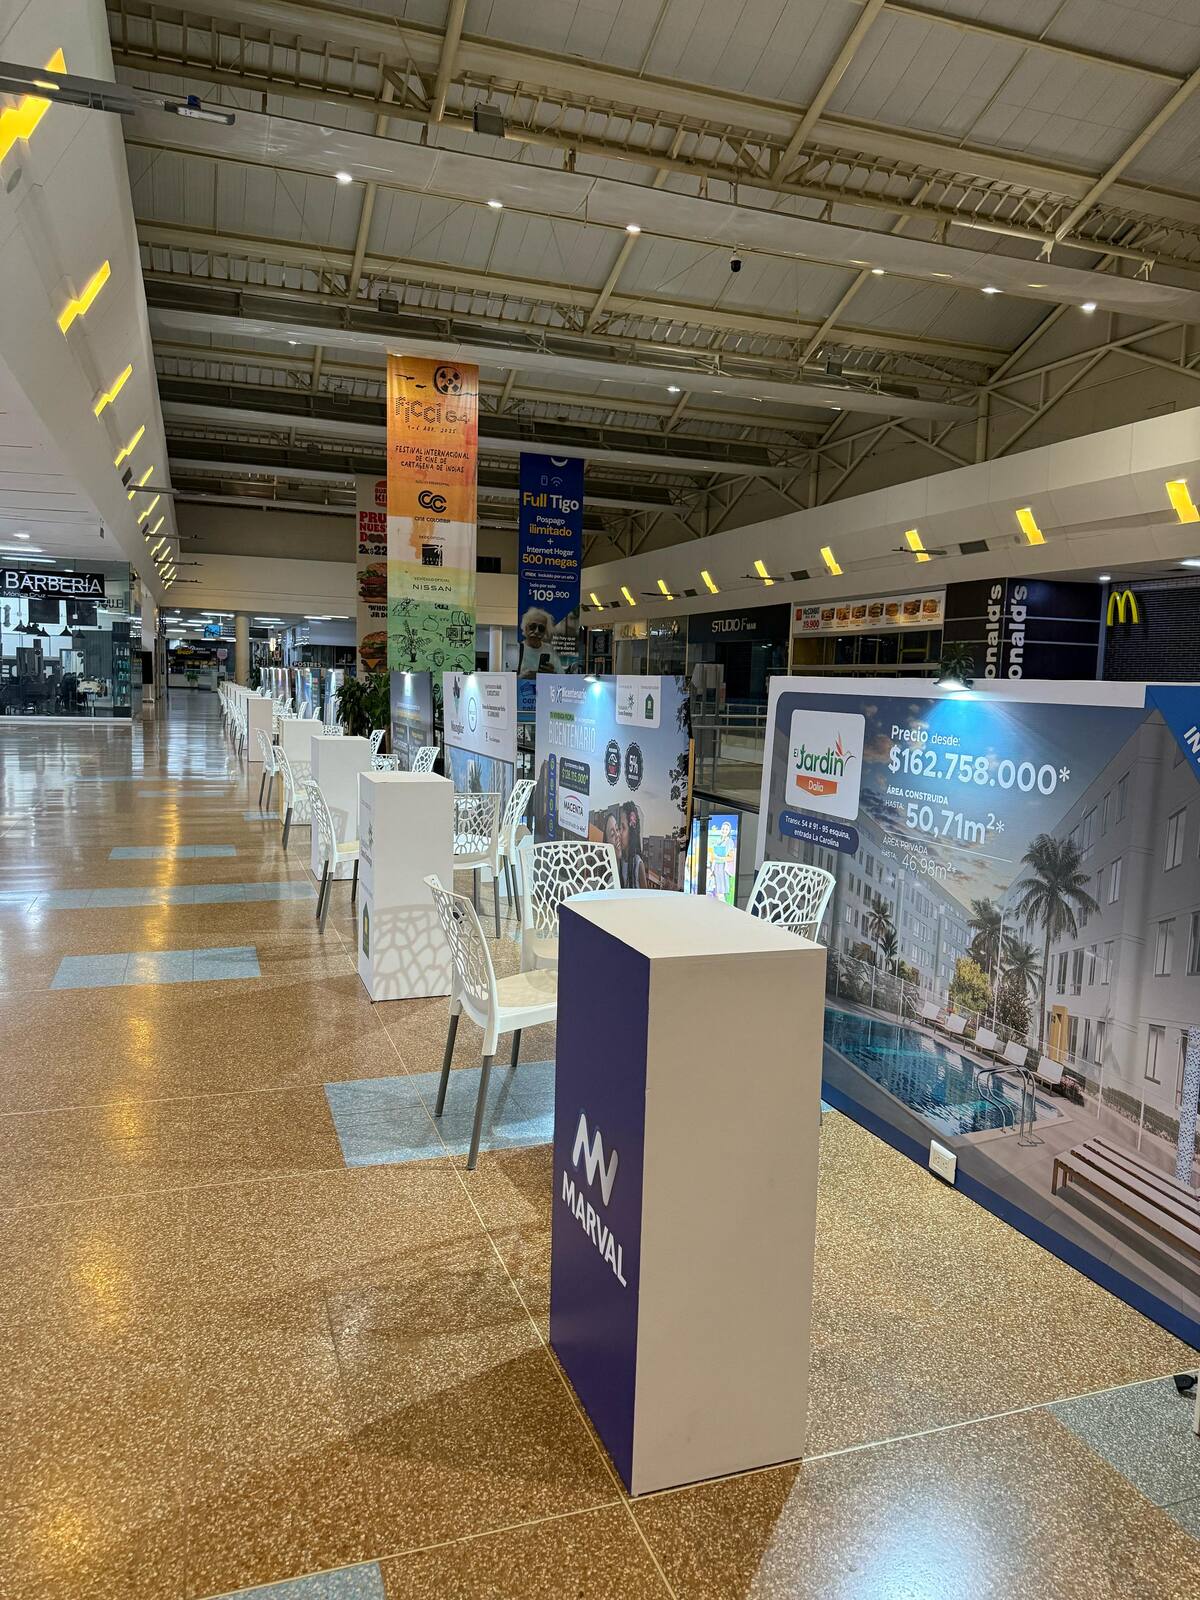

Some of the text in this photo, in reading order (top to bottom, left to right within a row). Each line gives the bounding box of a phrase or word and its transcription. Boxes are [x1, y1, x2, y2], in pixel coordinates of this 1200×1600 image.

[396, 445, 470, 460] FESTIVAL INTERNACIONAL
[401, 460, 434, 470] CARTAGENA
[446, 465, 464, 473] INDIAS
[425, 456, 437, 464] CINE
[523, 491, 579, 513] Full Tigo
[359, 522, 387, 533] NUES
[536, 515, 565, 526] Pospago
[529, 523, 572, 537] ilimitado
[527, 546, 574, 557] Internet Hogar
[522, 554, 577, 568] 500 megas
[5, 571, 103, 594] BARBERÍA
[412, 584, 452, 592] NISSAN
[528, 588, 569, 602] $109.900
[711, 618, 740, 633] STUDIO
[548, 720, 596, 753] BICENTENARIO
[891, 725, 961, 747] Precio desde:
[808, 780, 824, 793] Dalia
[886, 784, 949, 806] ÁREA CONSTRUIDA
[885, 799, 905, 810] HASTA:
[801, 819, 808, 828] 54
[822, 824, 829, 834] 95
[829, 828, 851, 841] esquina,
[794, 830, 840, 848] entrada La Carolina
[900, 839, 928, 855] PRIVADA
[562, 1170, 627, 1287] MARVAL
